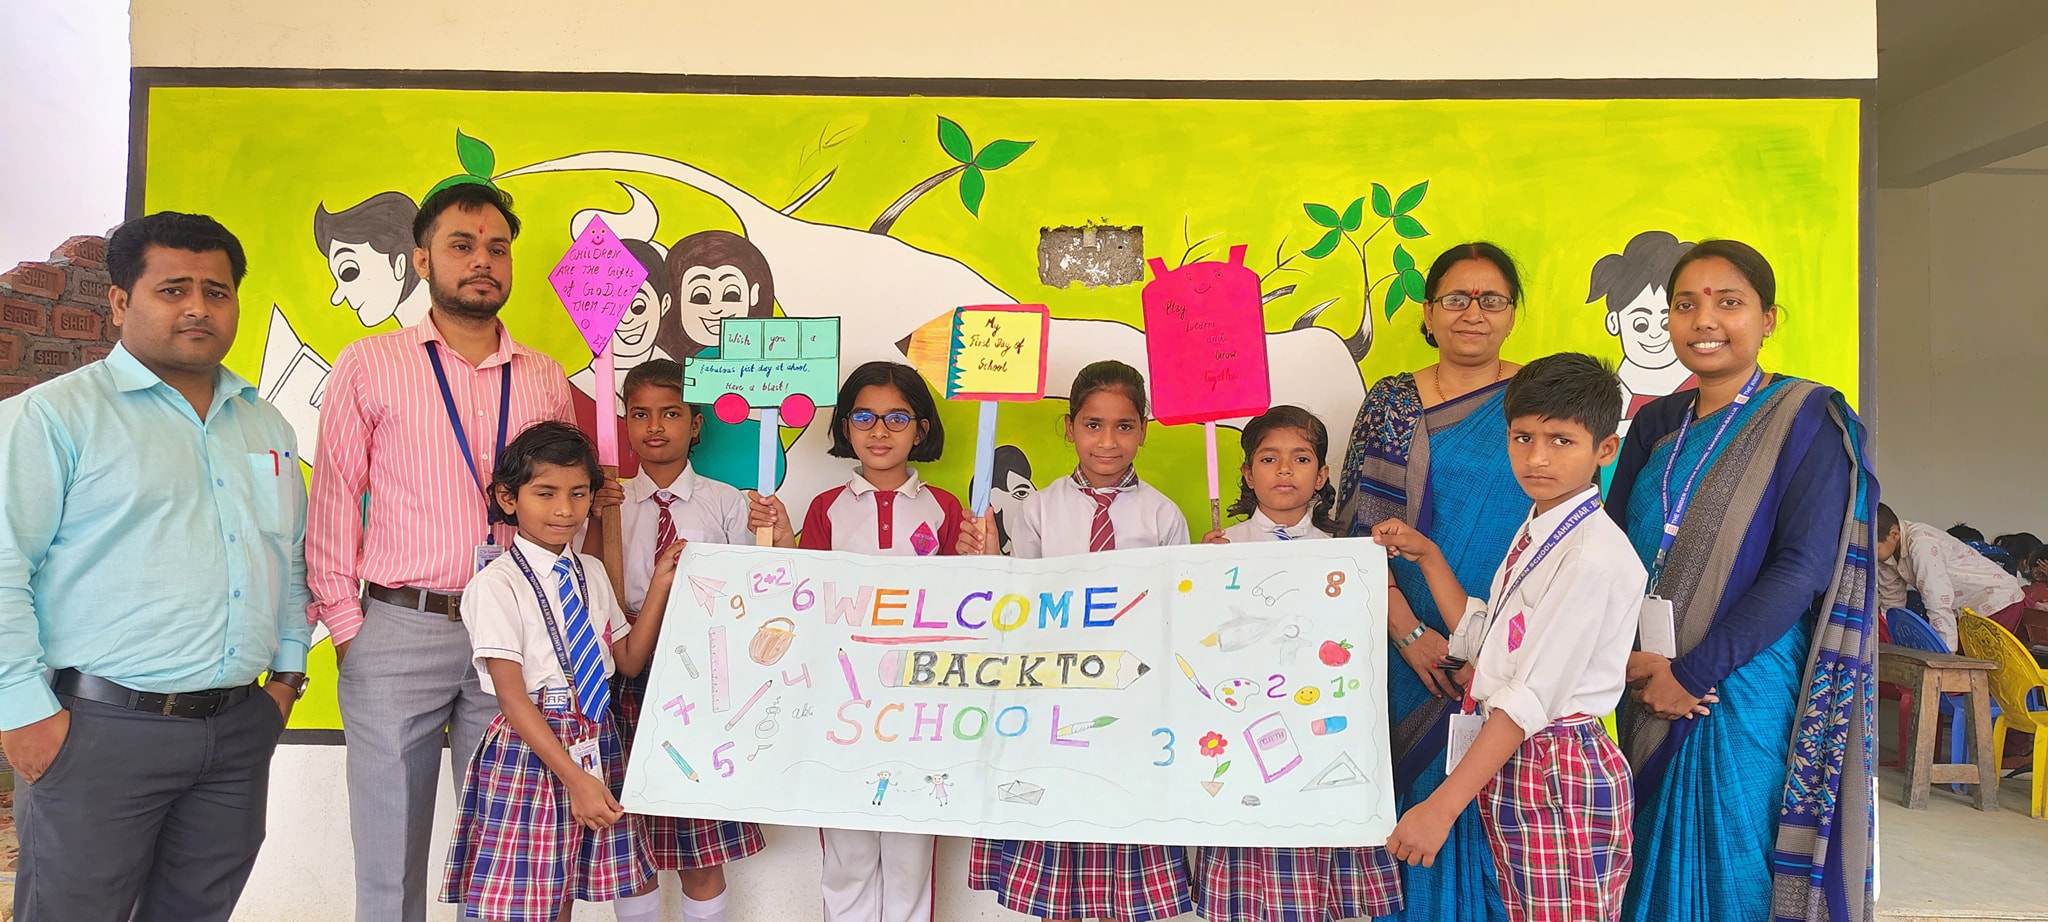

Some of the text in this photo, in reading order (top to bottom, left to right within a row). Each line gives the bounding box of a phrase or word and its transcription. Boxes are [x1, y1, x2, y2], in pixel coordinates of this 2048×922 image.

[563, 280, 575, 297] of
[1165, 300, 1186, 320] Play
[62, 316, 91, 331] SHRI
[985, 316, 1001, 337] My
[729, 333, 751, 345] Wish
[769, 335, 786, 351] you
[969, 334, 1025, 357] First Day of
[1207, 332, 1225, 343] and
[700, 364, 735, 375] fabulous
[758, 364, 772, 378] day
[776, 363, 784, 372] at
[978, 357, 1007, 372] School
[726, 382, 744, 391] Have
[1744, 384, 1753, 396] THE
[1671, 512, 1680, 524] THE
[1676, 492, 1687, 512] KINDER
[1684, 470, 1698, 492] GARTEN
[1530, 541, 1556, 568] SCHOOL,
[1553, 507, 1590, 541] SAHATWAR
[1225, 566, 1241, 590] 1
[1325, 571, 1346, 597] 8
[730, 594, 746, 620] 9
[792, 578, 815, 611] 6
[823, 581, 1118, 629] WELCOME
[540, 598, 554, 625] GARTEN
[550, 625, 563, 651] KINDER
[557, 651, 567, 666] THE
[909, 651, 1105, 687] BACK TO
[782, 663, 812, 689] 4
[1267, 674, 1288, 698] 2
[662, 695, 696, 726] 7
[826, 699, 1090, 747] SCHOOL
[713, 741, 735, 778] 5
[1152, 728, 1176, 766] 3
